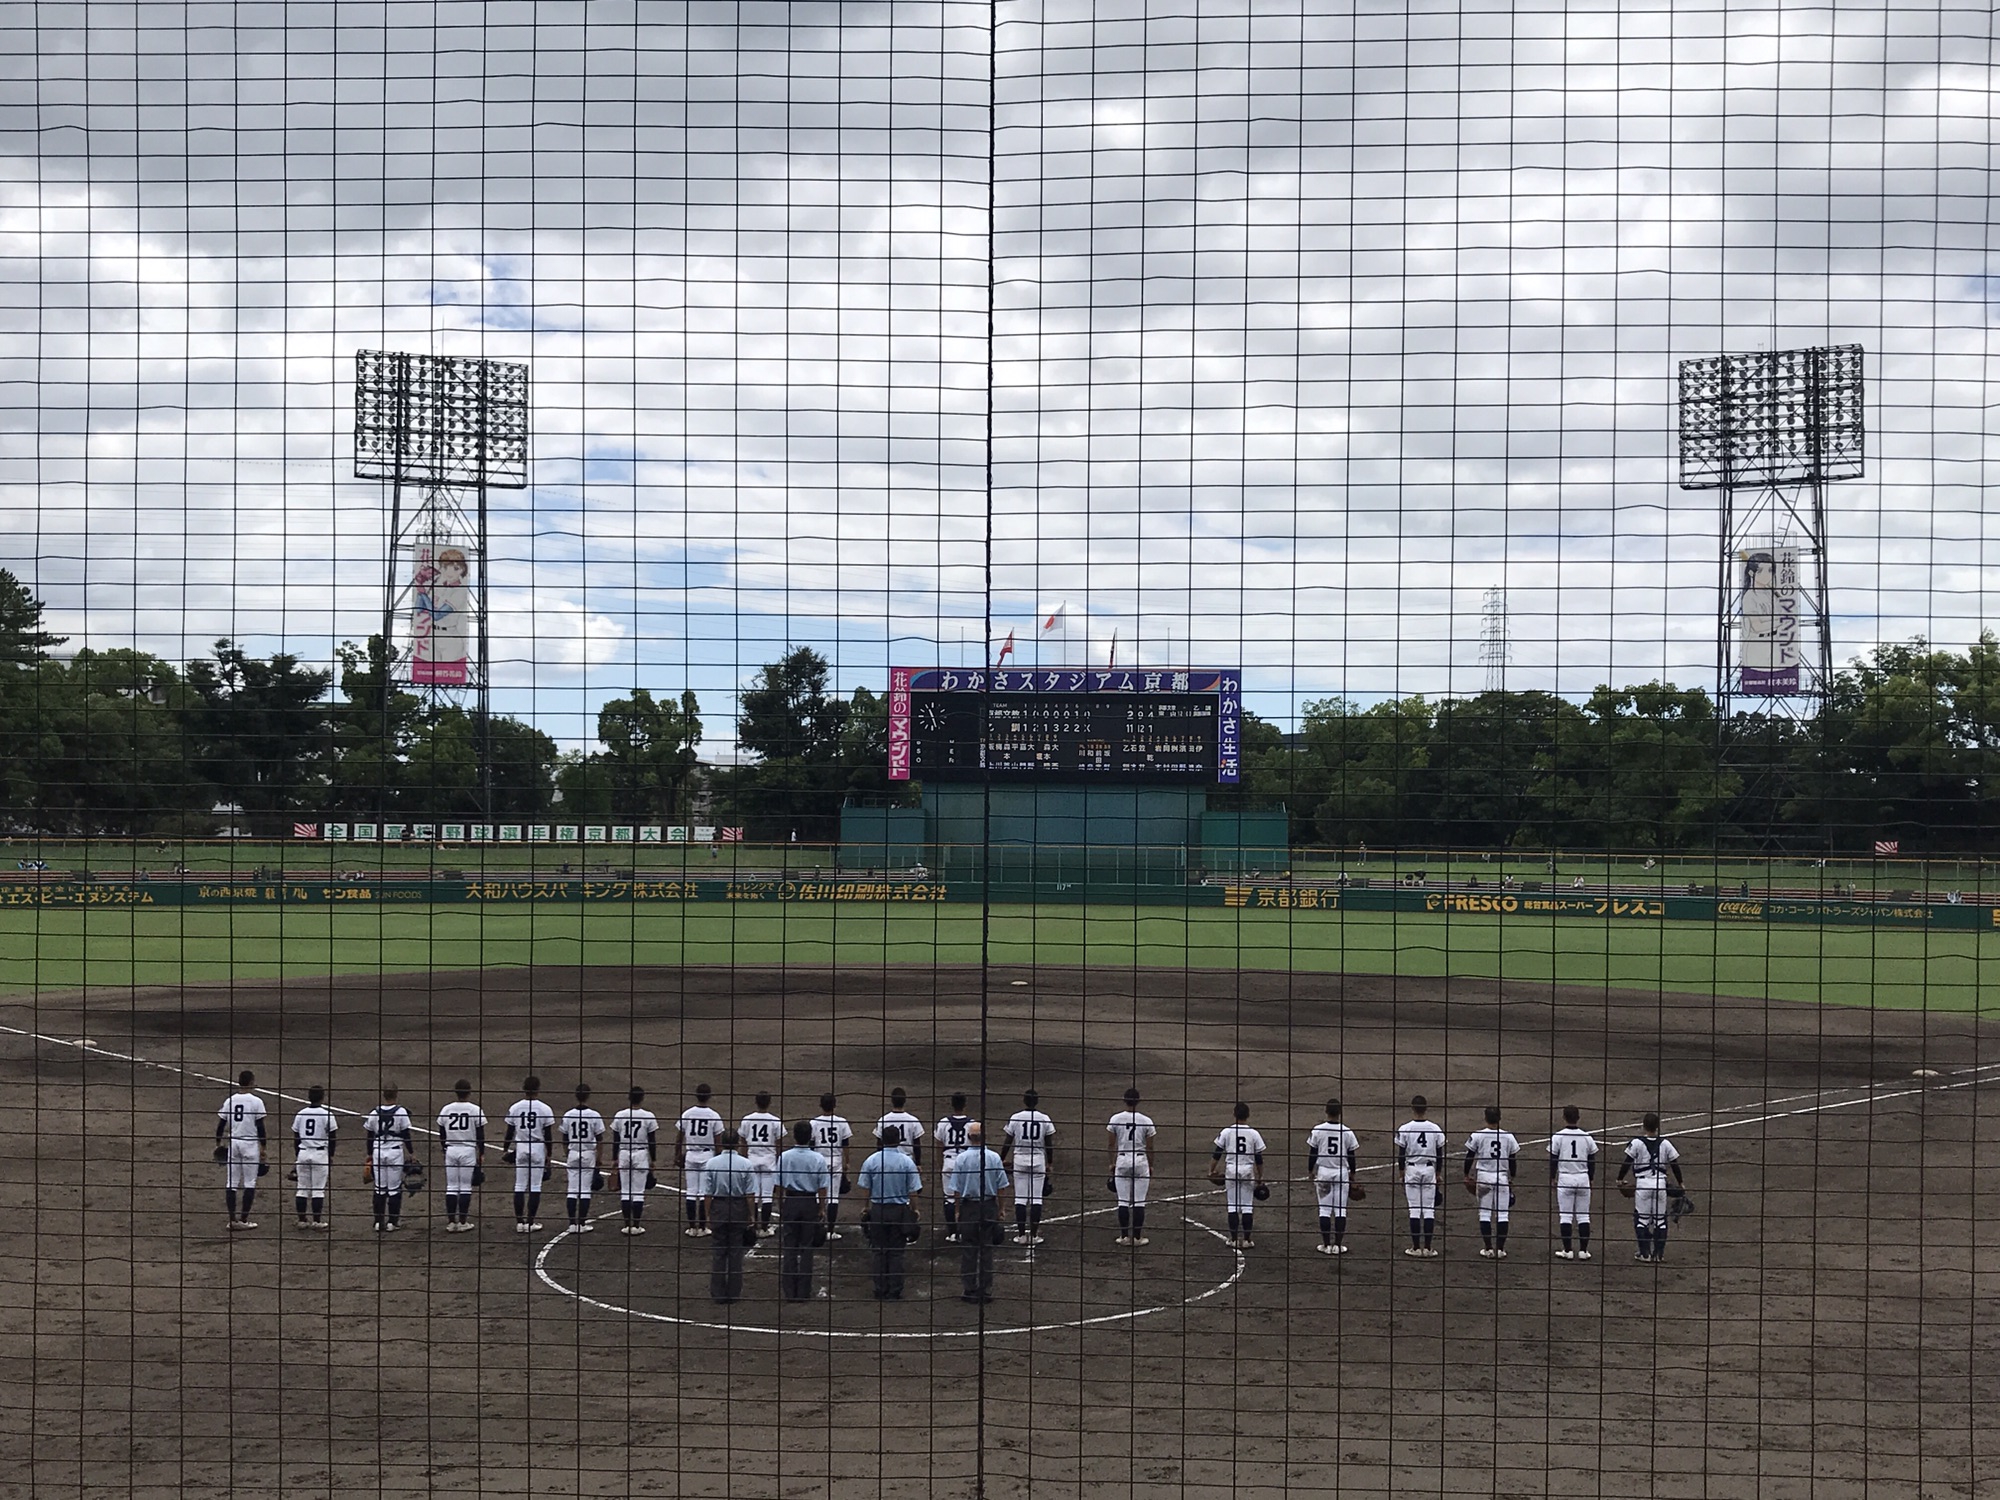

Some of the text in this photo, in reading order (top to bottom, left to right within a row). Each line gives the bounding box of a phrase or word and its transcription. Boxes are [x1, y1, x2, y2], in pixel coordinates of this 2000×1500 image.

[941, 670, 1189, 692] わかさスタジアム京都
[1222, 677, 1238, 776] わかさ生活
[1256, 888, 1340, 908] 京都銀行
[234, 1104, 244, 1122] 8
[448, 1112, 469, 1130] 20
[306, 1118, 316, 1136] 9
[571, 1122, 588, 1139] 18
[624, 1121, 642, 1138] 17
[752, 1124, 768, 1142] 14
[819, 1127, 838, 1144] 15
[1022, 1120, 1040, 1140] 10
[1126, 1123, 1136, 1140] 7
[1236, 1136, 1246, 1154] 6
[1328, 1136, 1338, 1154] 5
[1417, 1131, 1427, 1148] 4
[1490, 1141, 1501, 1159] 3
[1571, 1140, 1578, 1158] 1
